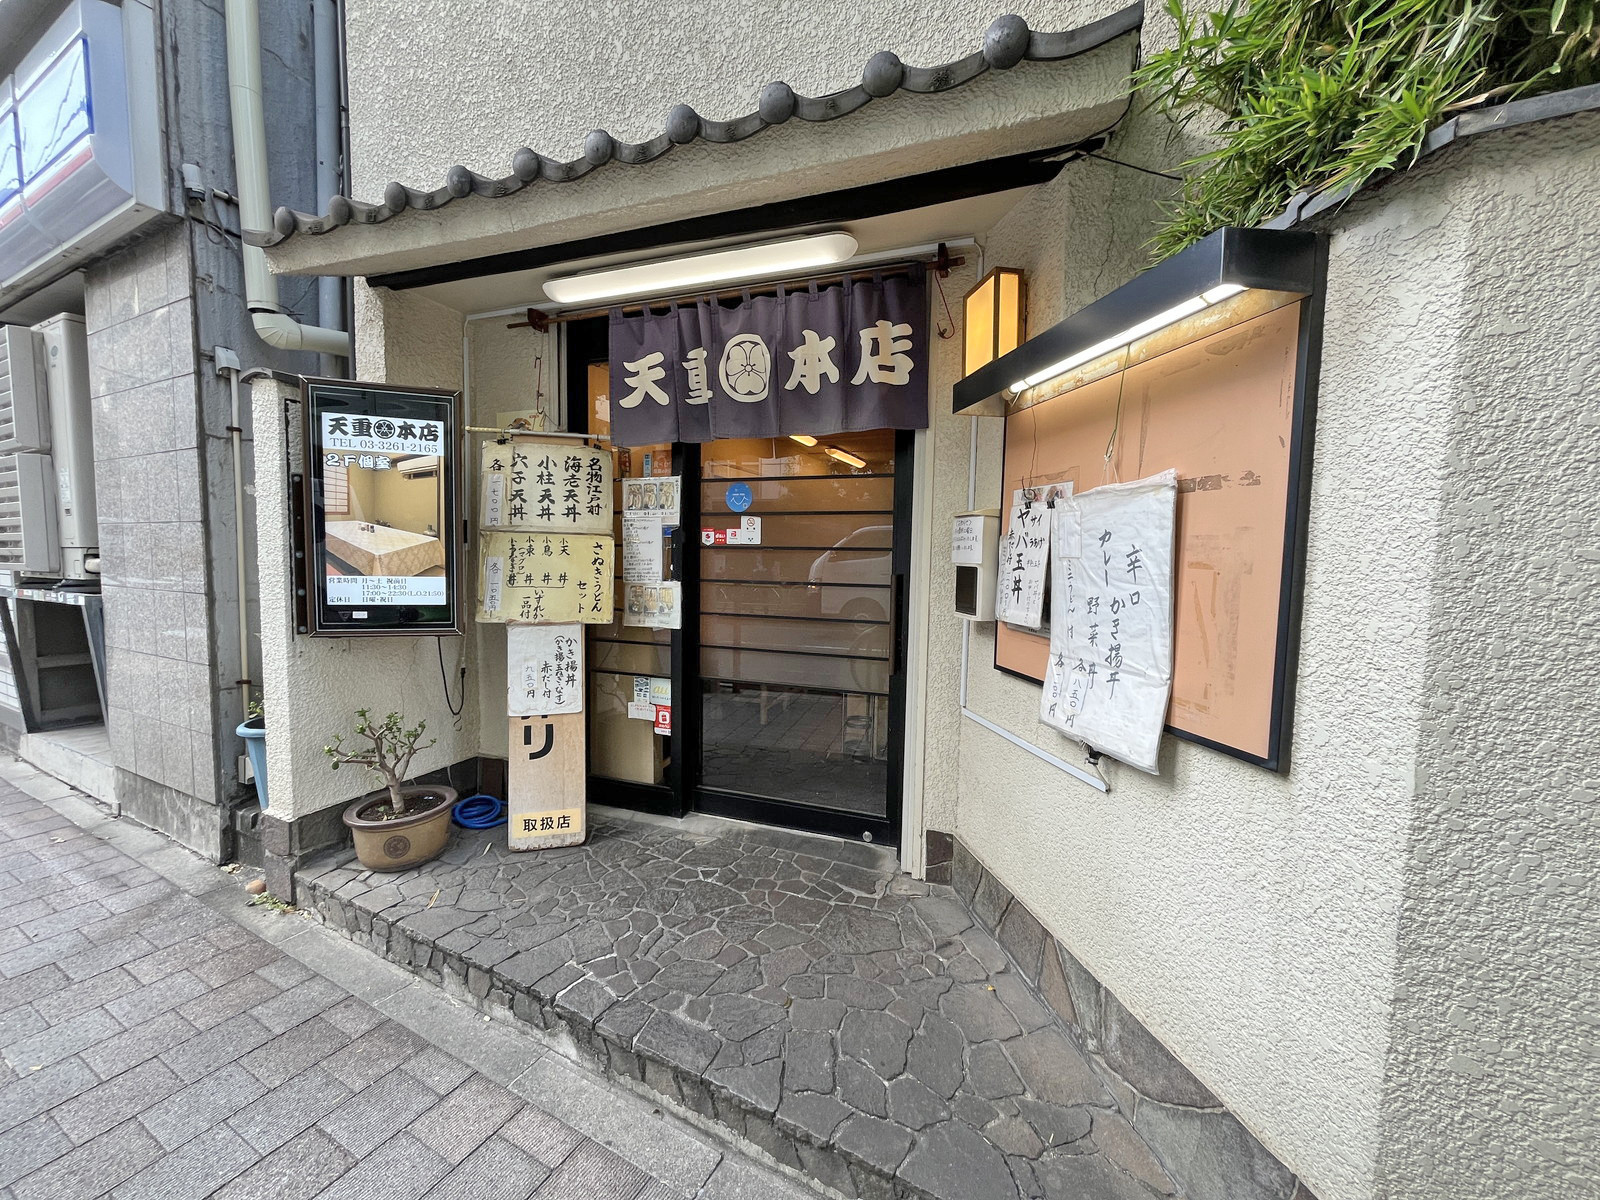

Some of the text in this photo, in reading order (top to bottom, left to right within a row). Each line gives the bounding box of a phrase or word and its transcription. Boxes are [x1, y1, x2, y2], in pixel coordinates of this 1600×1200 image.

[784, 319, 915, 395] 本店
[328, 416, 440, 443] 天重 本店
[330, 437, 438, 454] TEL 03-3261-2165
[561, 455, 583, 523] 海老天丼
[521, 715, 554, 760] リ
[523, 814, 571, 833] 取扱店
